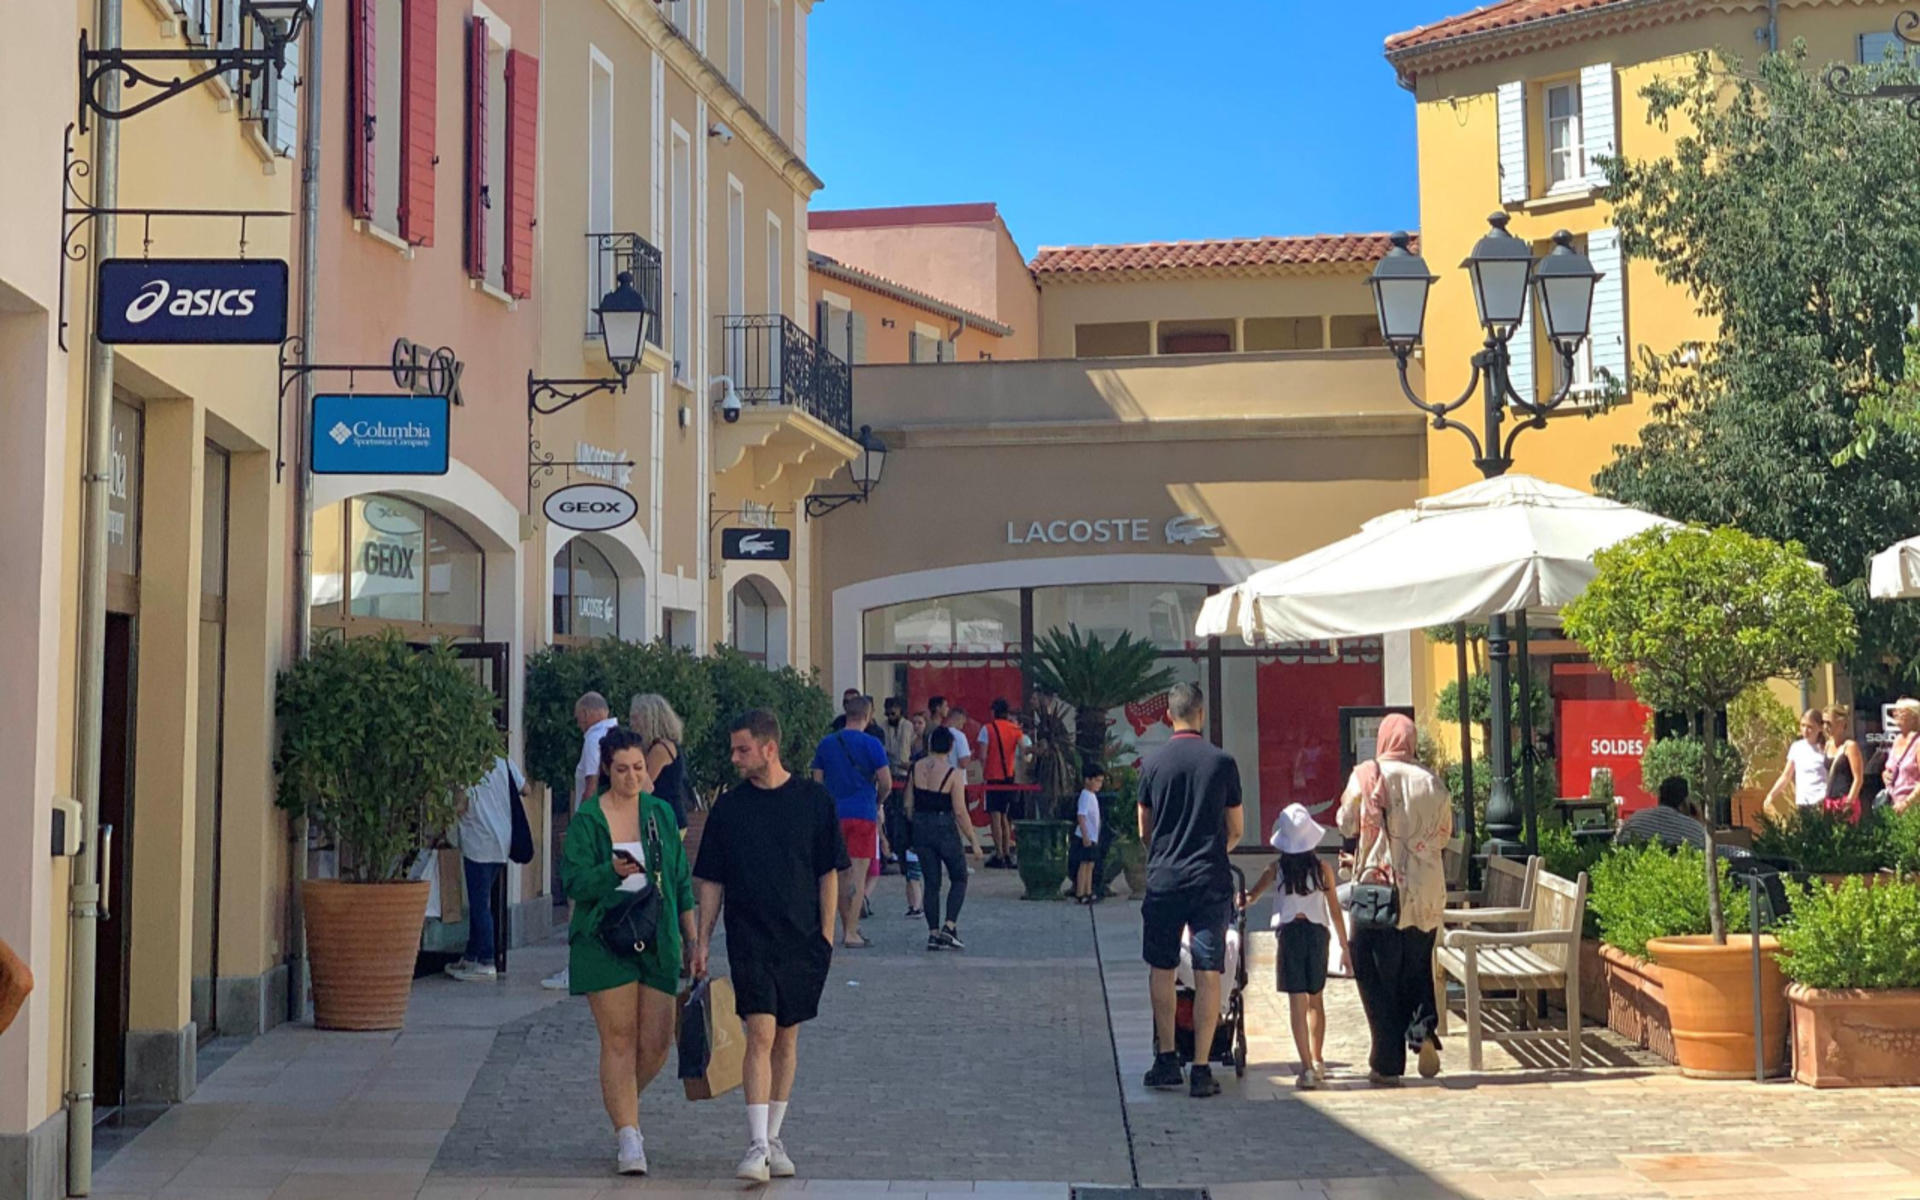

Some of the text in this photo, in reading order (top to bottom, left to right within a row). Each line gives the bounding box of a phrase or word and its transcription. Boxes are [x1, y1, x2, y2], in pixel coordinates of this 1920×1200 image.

[168, 289, 256, 316] asics
[392, 337, 464, 406] GEOX
[353, 421, 431, 438] Columbia
[559, 502, 620, 513] GEOX
[1007, 519, 1149, 544] LACOSTE
[364, 541, 414, 580] GEOX
[1591, 739, 1643, 755] SOLDES
